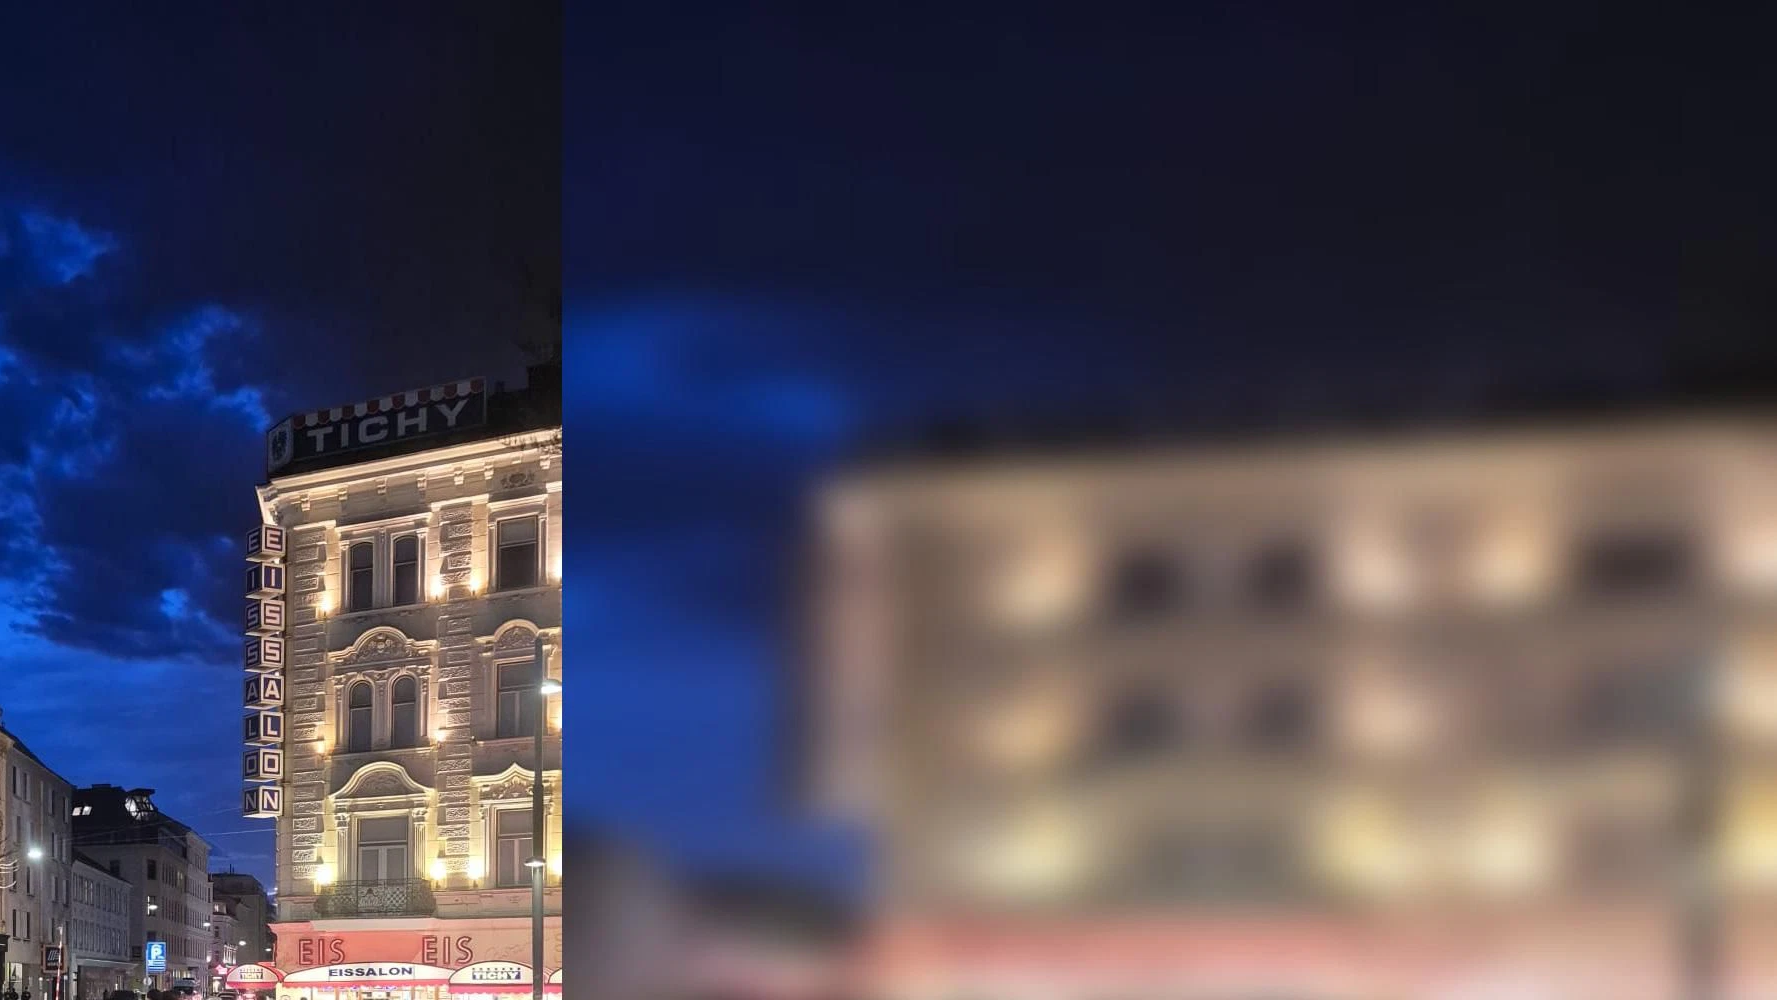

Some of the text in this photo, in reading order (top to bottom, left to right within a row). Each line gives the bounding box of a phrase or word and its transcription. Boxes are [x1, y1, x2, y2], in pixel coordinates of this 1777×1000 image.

[307, 397, 470, 453] TICHY
[245, 533, 259, 811] EISSALON
[263, 528, 282, 811] EISSALON
[298, 939, 346, 966] EIS
[421, 935, 474, 966] EIS
[328, 967, 413, 977] EISSALON
[473, 971, 519, 980] TICHY
